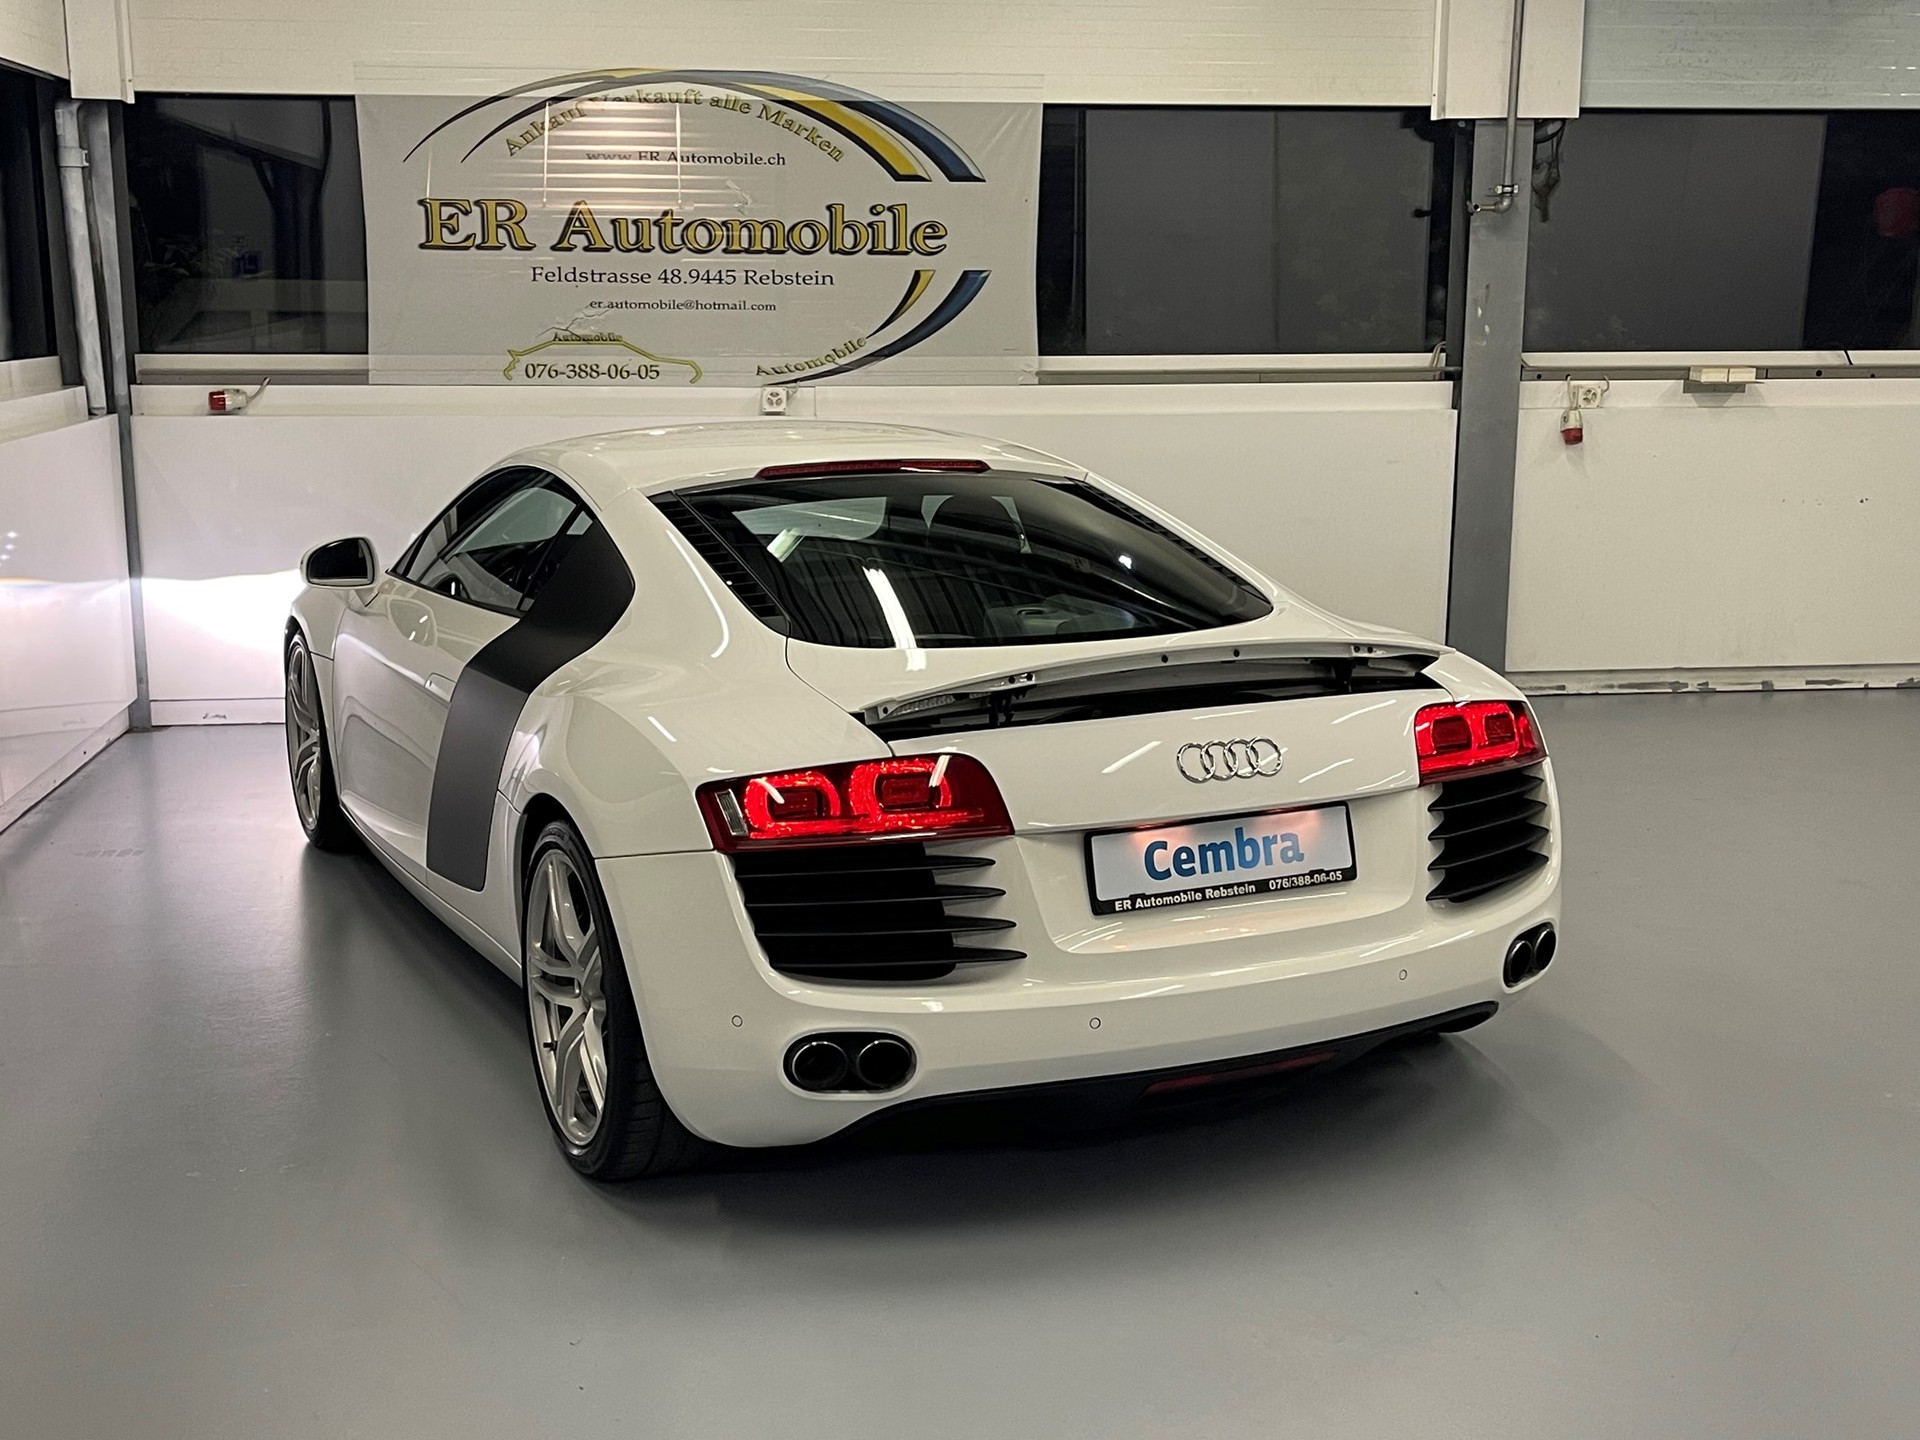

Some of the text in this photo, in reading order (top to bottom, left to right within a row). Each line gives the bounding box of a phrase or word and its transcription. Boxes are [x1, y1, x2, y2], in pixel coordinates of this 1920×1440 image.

[505, 100, 587, 157] Ankauf
[709, 94, 752, 114] alle
[756, 103, 845, 162] Marken
[638, 151, 660, 162] ER
[667, 152, 786, 166] Automobile.ch
[418, 197, 948, 256] ER Automobile
[531, 266, 834, 286] Feldstrasse 48.9445 Rebstein
[589, 299, 777, 312] er.automobile@hotmail.com
[524, 362, 661, 380] 076-388-06-05
[755, 336, 867, 376] Automobile
[1143, 826, 1305, 882] Cembra
[1114, 870, 1343, 912] ER Automobile Rebstein 076/388-06-05
